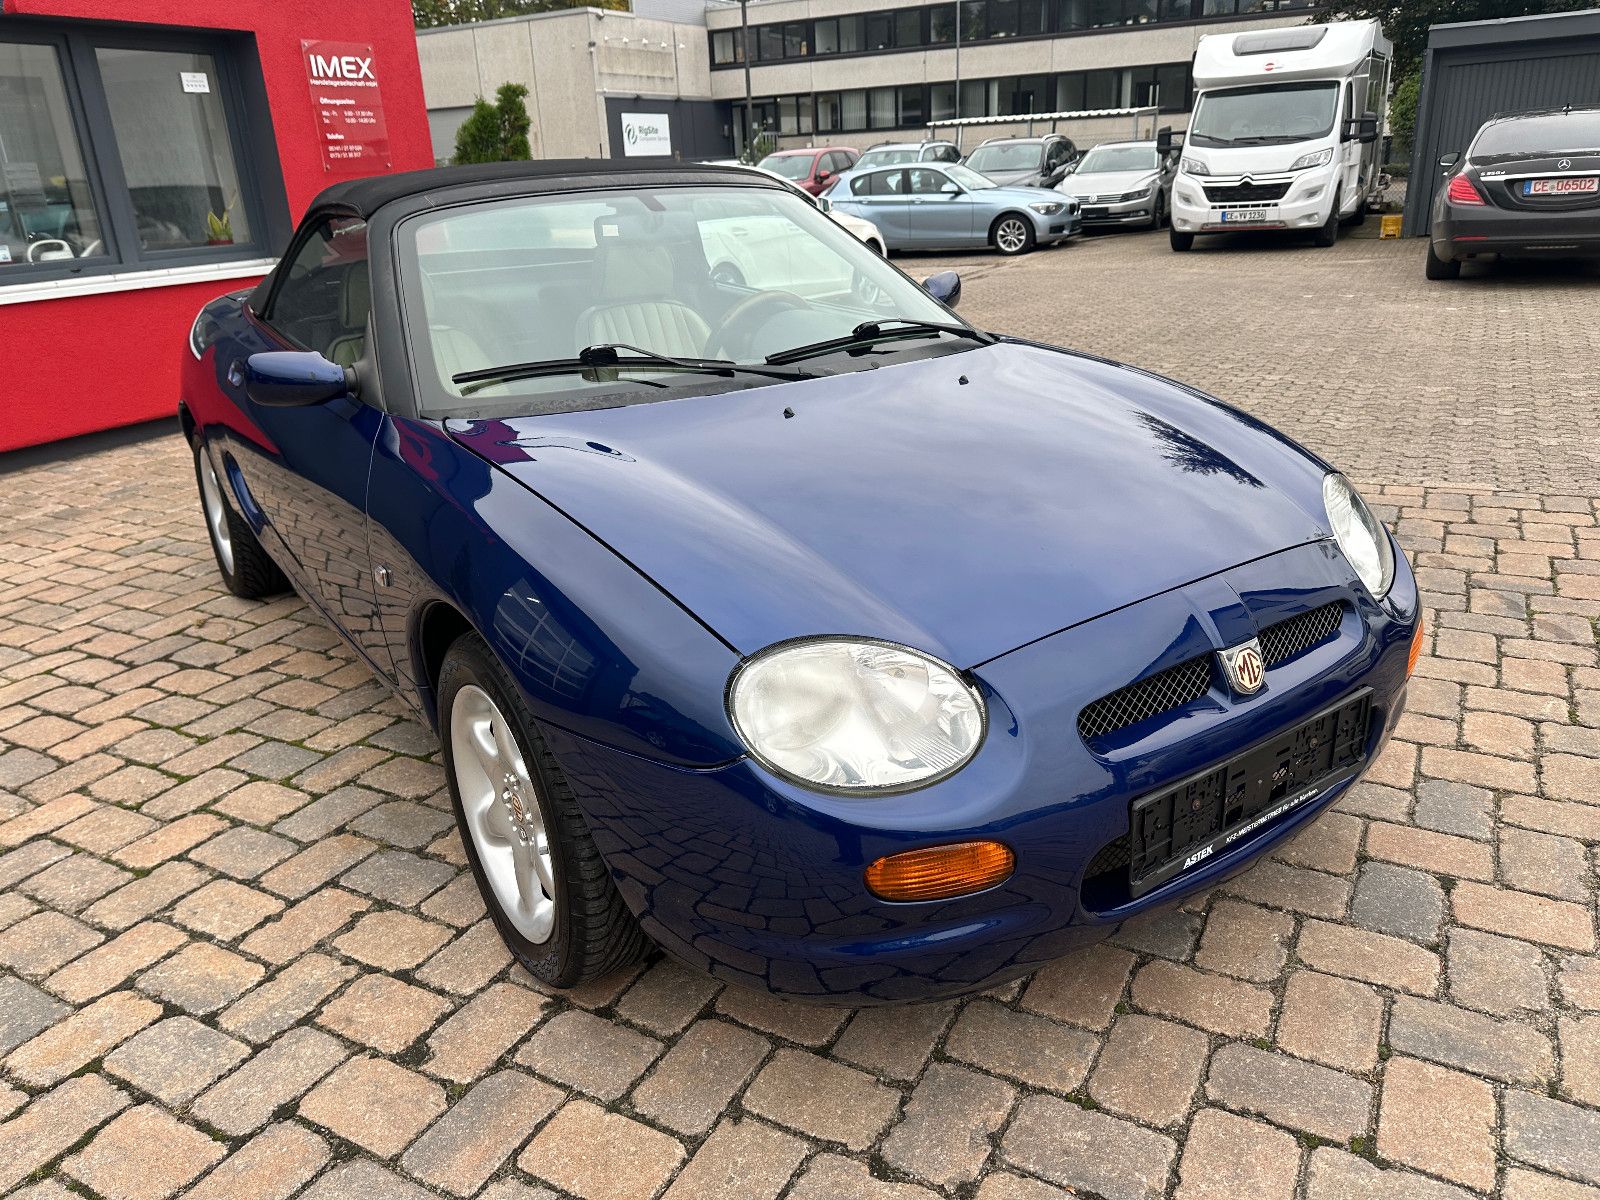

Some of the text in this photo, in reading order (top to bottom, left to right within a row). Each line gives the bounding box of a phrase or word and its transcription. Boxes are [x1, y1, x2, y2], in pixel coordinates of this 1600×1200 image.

[309, 54, 375, 79] IMEX
[1533, 179, 1595, 192] CE 06502
[1237, 652, 1261, 685] MG
[1183, 844, 1213, 870] ASTEK
